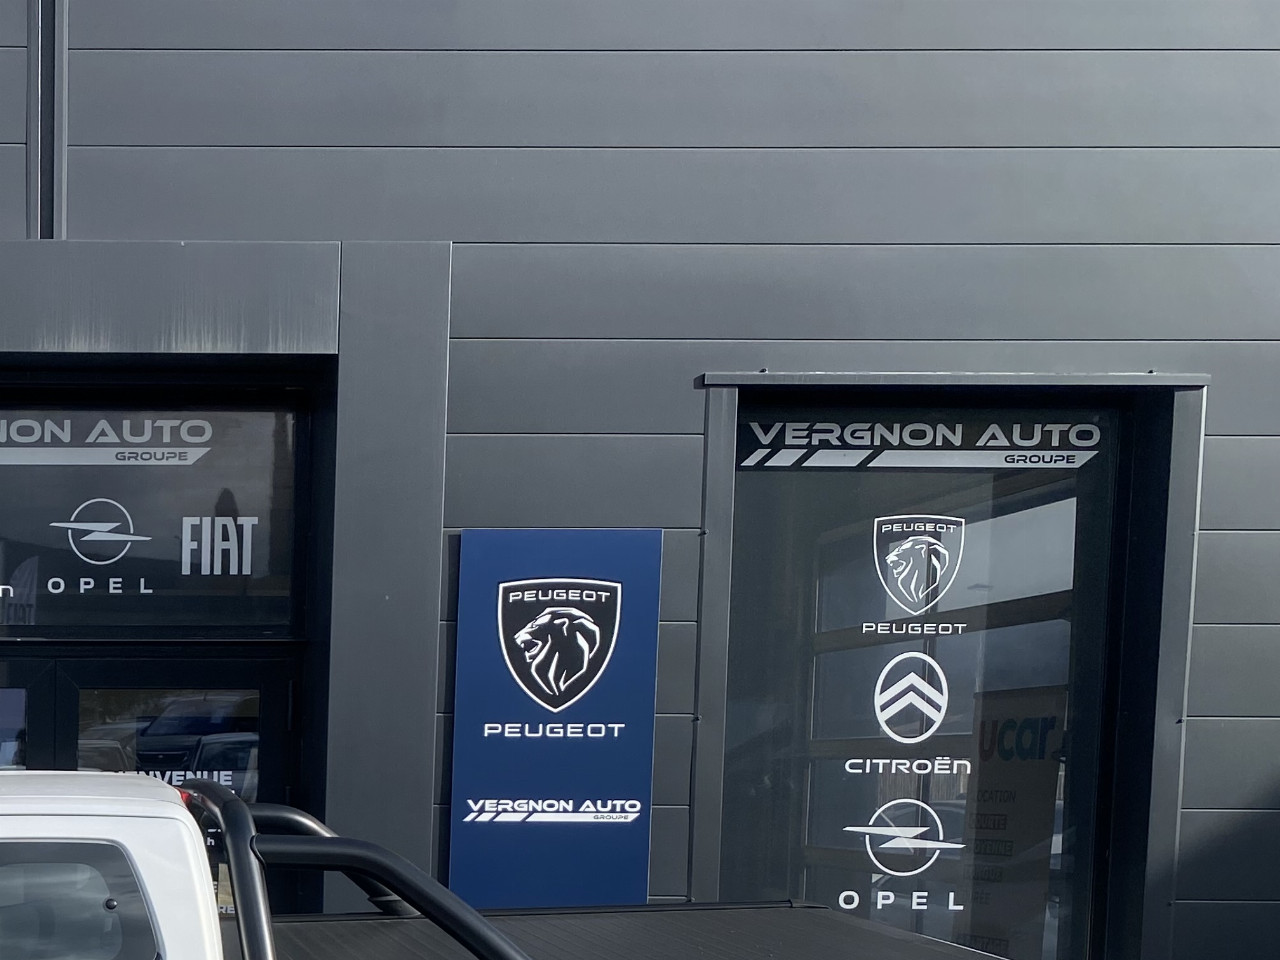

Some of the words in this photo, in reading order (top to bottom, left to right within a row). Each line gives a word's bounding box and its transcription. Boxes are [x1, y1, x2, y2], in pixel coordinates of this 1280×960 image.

[85, 419, 213, 444] AUTO
[749, 422, 963, 446] VERGNON
[975, 423, 1101, 447] AUTO
[115, 451, 189, 462] GROUPE
[1004, 453, 1076, 465] GROUPE
[881, 522, 957, 533] PEUGEOT
[181, 516, 259, 576] FIAT
[47, 577, 153, 594] OPEL
[509, 589, 611, 603] PEUGEOT
[862, 622, 967, 635] PEUGEOT
[484, 723, 626, 737] PEUGEOT
[467, 799, 574, 812] VERGNON
[578, 800, 642, 812] AUTO
[838, 890, 964, 911] OPEL
